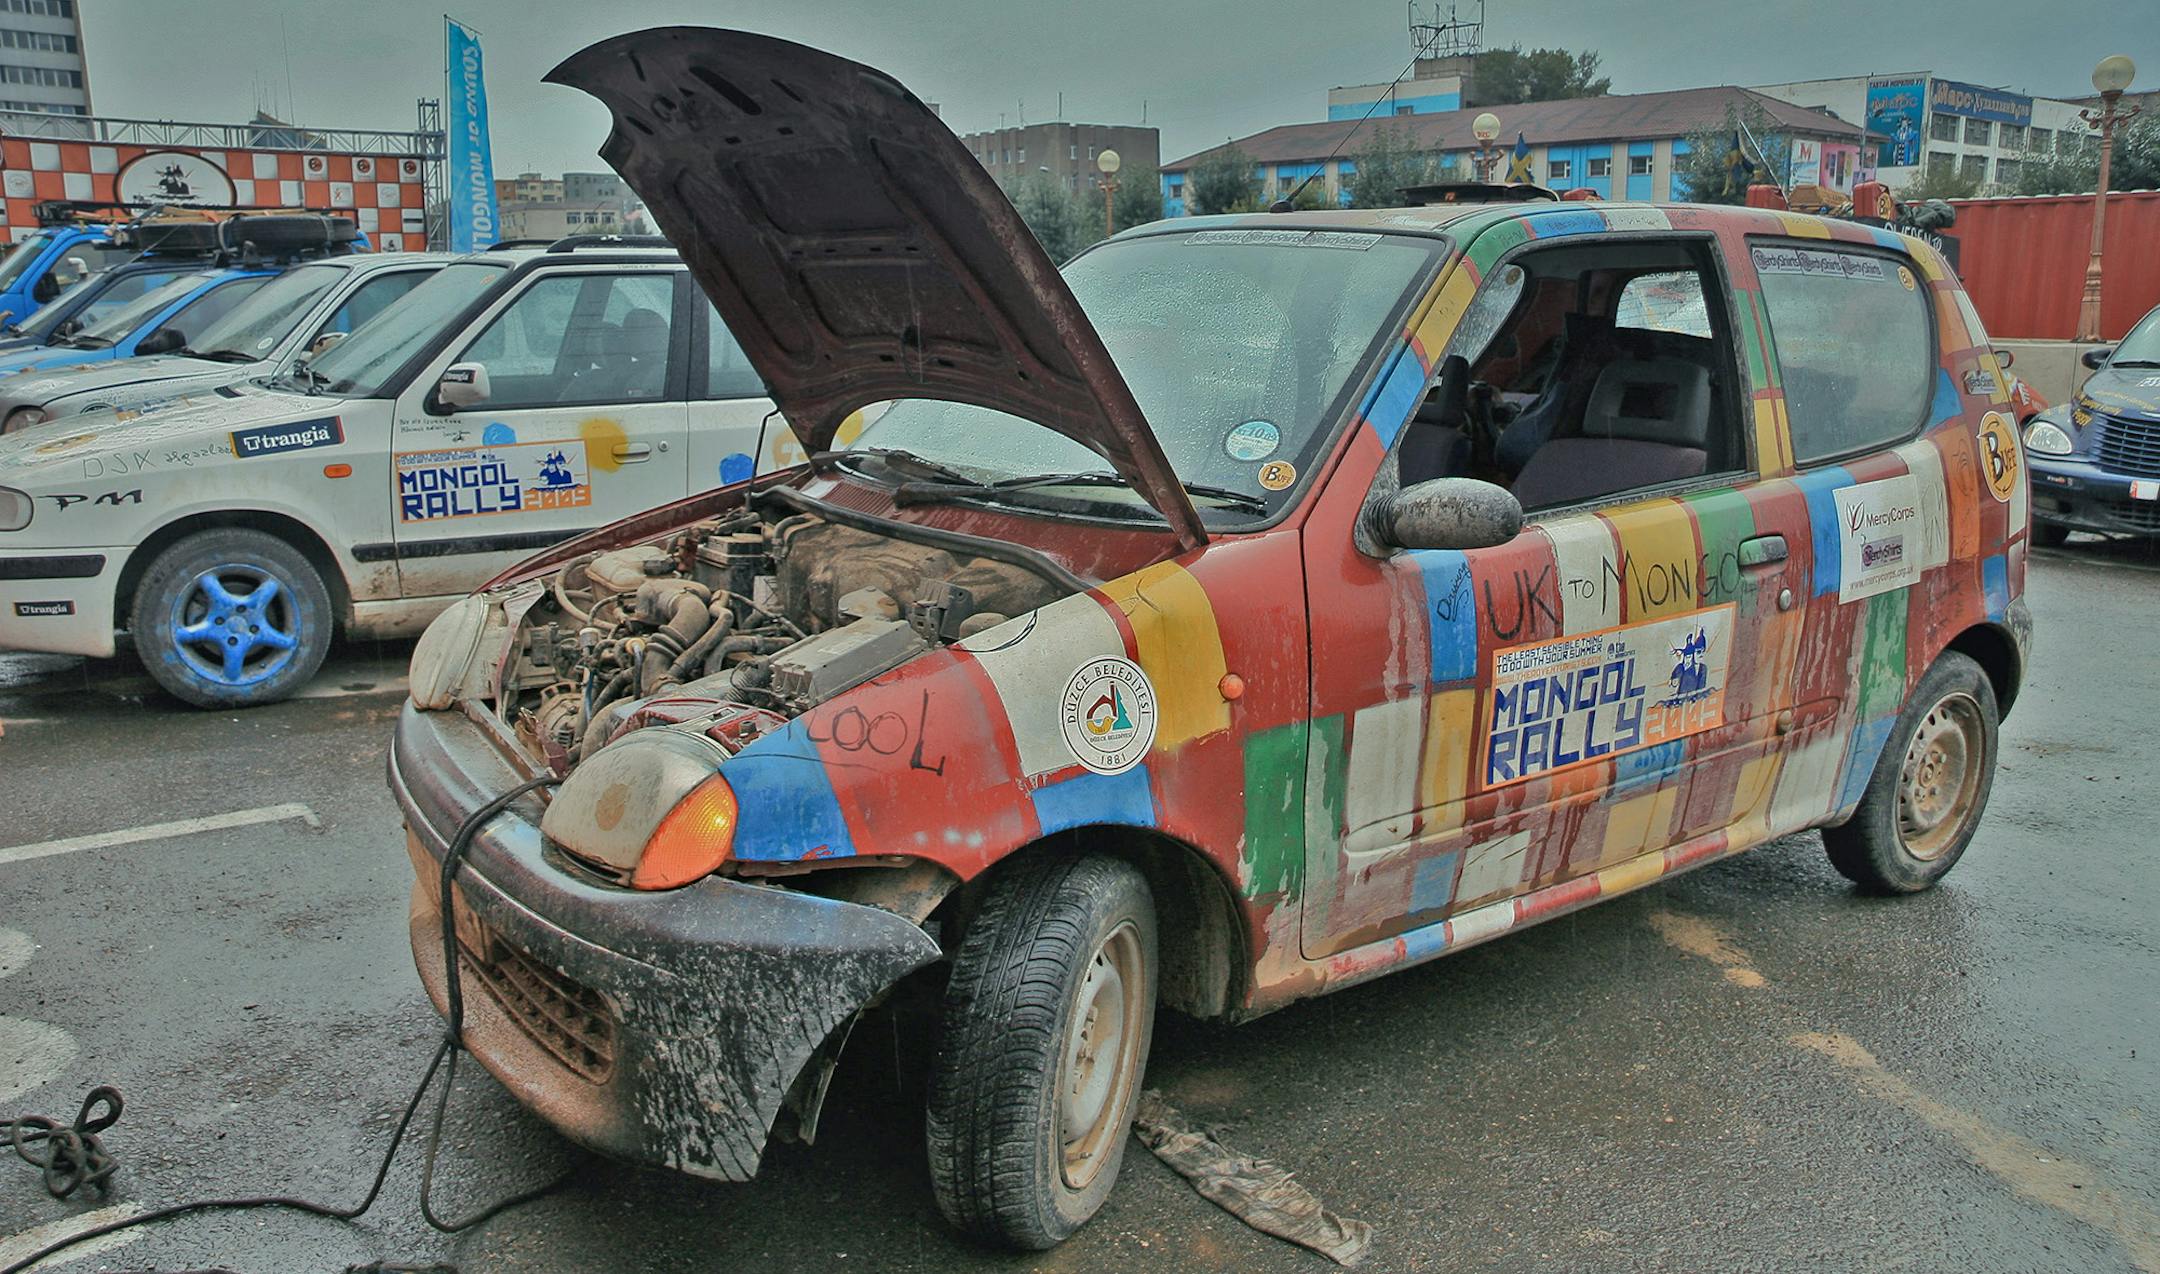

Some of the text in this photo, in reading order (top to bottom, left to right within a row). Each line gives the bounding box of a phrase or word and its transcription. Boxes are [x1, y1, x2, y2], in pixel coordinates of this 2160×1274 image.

[261, 426, 331, 451] trangia
[399, 463, 519, 493] MONGOL
[402, 485, 587, 520] RALLY 2009
[1866, 506, 1915, 528] MercyCorps
[1484, 564, 1562, 641] UK
[1496, 652, 1512, 665] THE
[1514, 647, 1541, 660] LEAST
[1542, 640, 1581, 654] SENSIBLE
[1496, 664, 1508, 674] TO
[1509, 662, 1524, 672] DO
[1523, 656, 1545, 669] WITH
[1545, 651, 1569, 665] YOUR
[1569, 643, 1603, 659] SUMMER
[1066, 675, 1090, 724] DÜZCE
[1491, 658, 1647, 731] MONGOL
[1487, 698, 1645, 786] RALLY
[1101, 752, 1127, 766] 1881
